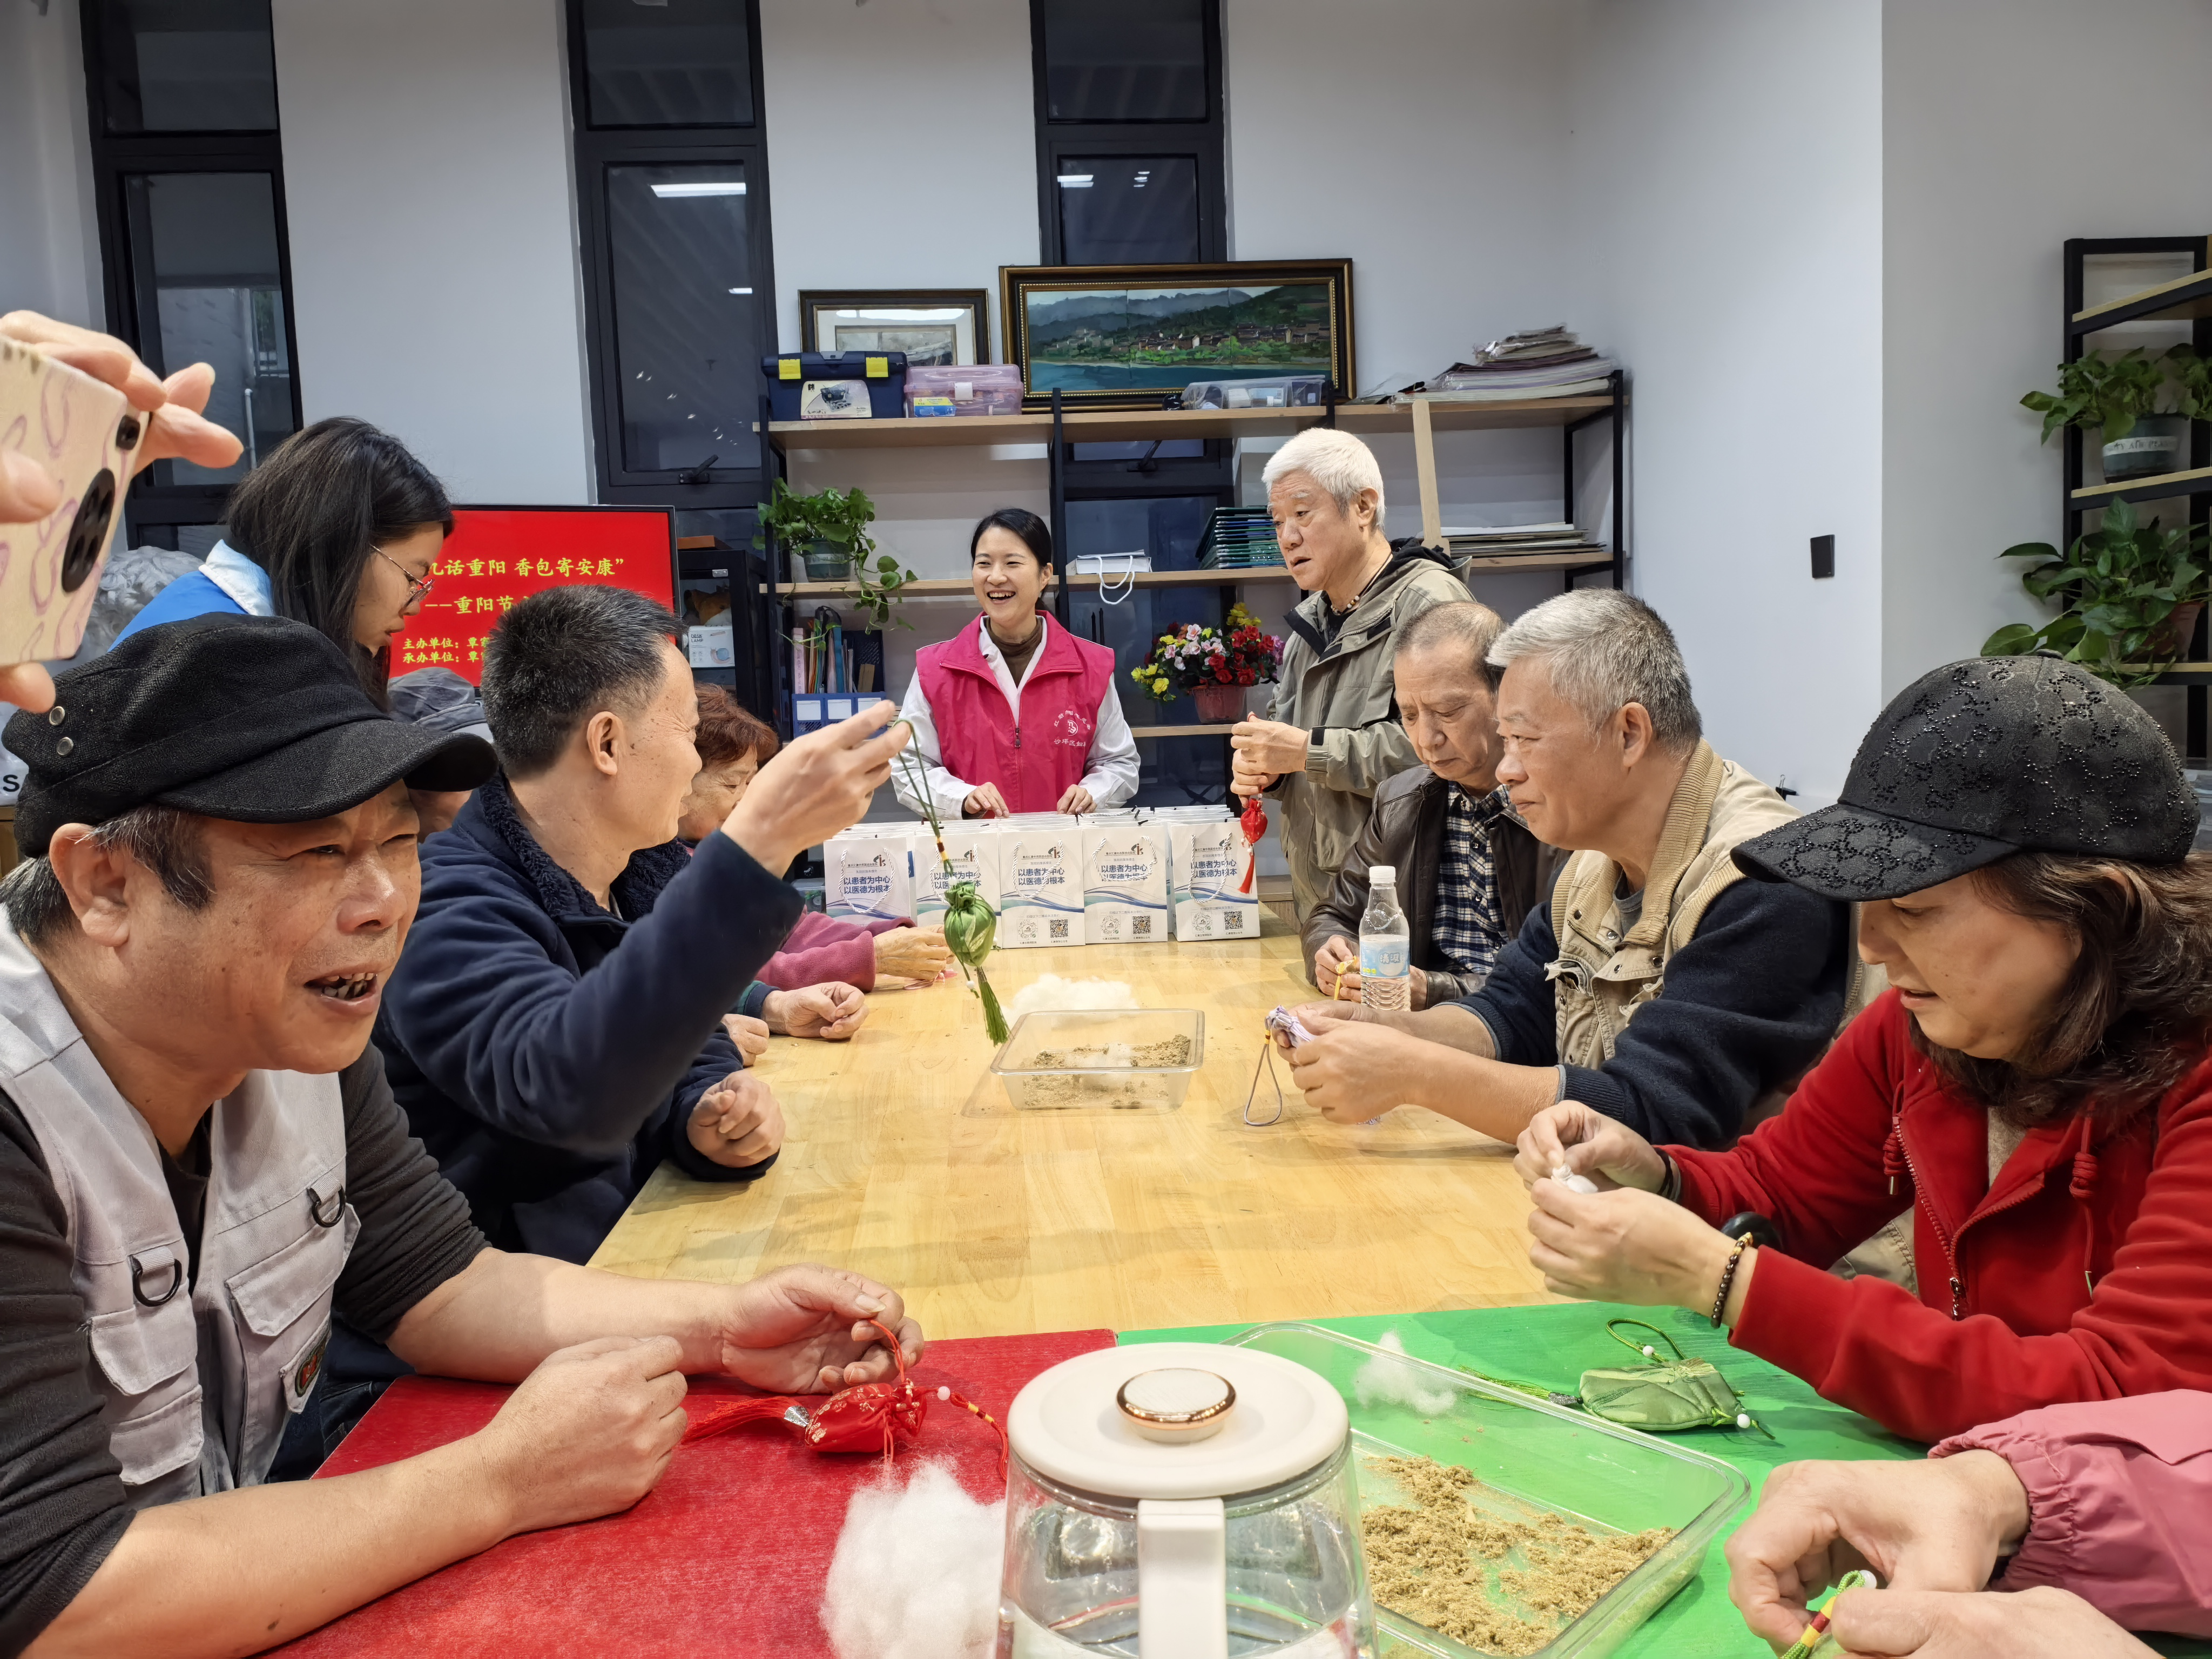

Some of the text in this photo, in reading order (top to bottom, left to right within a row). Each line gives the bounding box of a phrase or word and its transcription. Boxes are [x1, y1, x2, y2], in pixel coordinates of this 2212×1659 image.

[514, 558, 624, 577] 香包寄安康”
[1101, 864, 1148, 873] 以患者为中心
[844, 876, 890, 885] 以患者为中心
